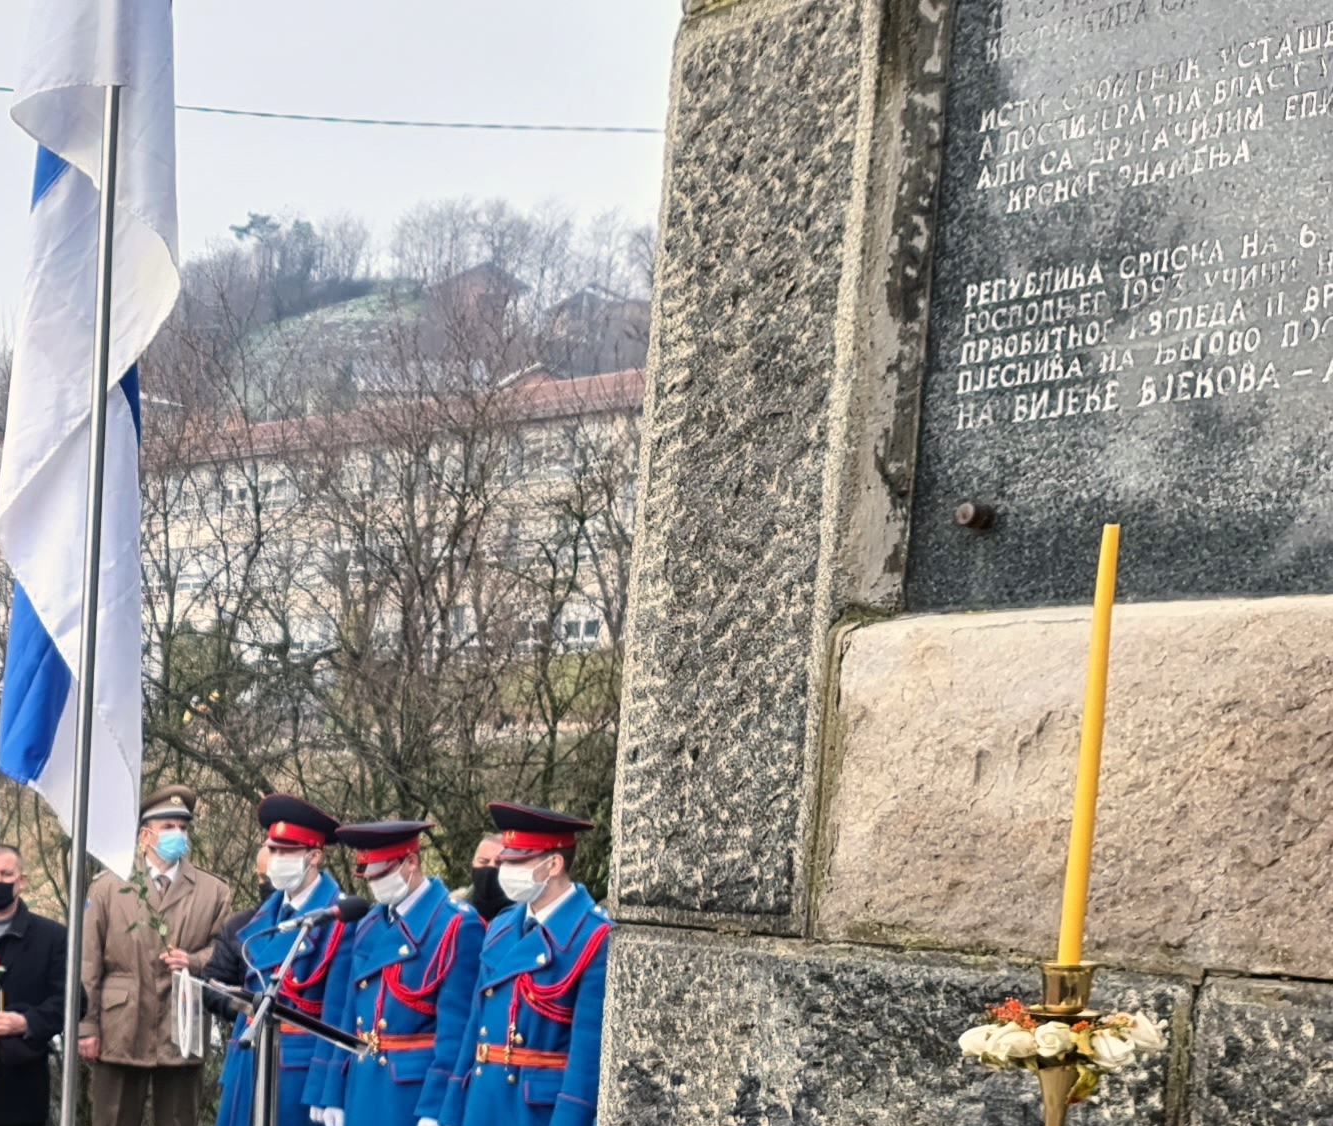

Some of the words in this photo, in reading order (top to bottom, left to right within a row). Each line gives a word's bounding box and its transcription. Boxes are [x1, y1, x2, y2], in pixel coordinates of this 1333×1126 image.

[979, 125, 994, 160] А
[976, 155, 1025, 190] АЛИ
[1040, 148, 1073, 175] СА
[965, 257, 1103, 308] РЕПУБЛИКА
[1120, 239, 1223, 279] СРПСКА
[1240, 229, 1277, 259] НА
[958, 318, 1114, 366] ПРВОБИТНОГ
[956, 354, 1083, 394] ПЈЕСНИКА
[1099, 349, 1134, 373] НА
[956, 402, 995, 430] НА
[1012, 380, 1119, 422] ВИЈЕКЕ
[1137, 361, 1280, 407] ВЈЕКОВА
